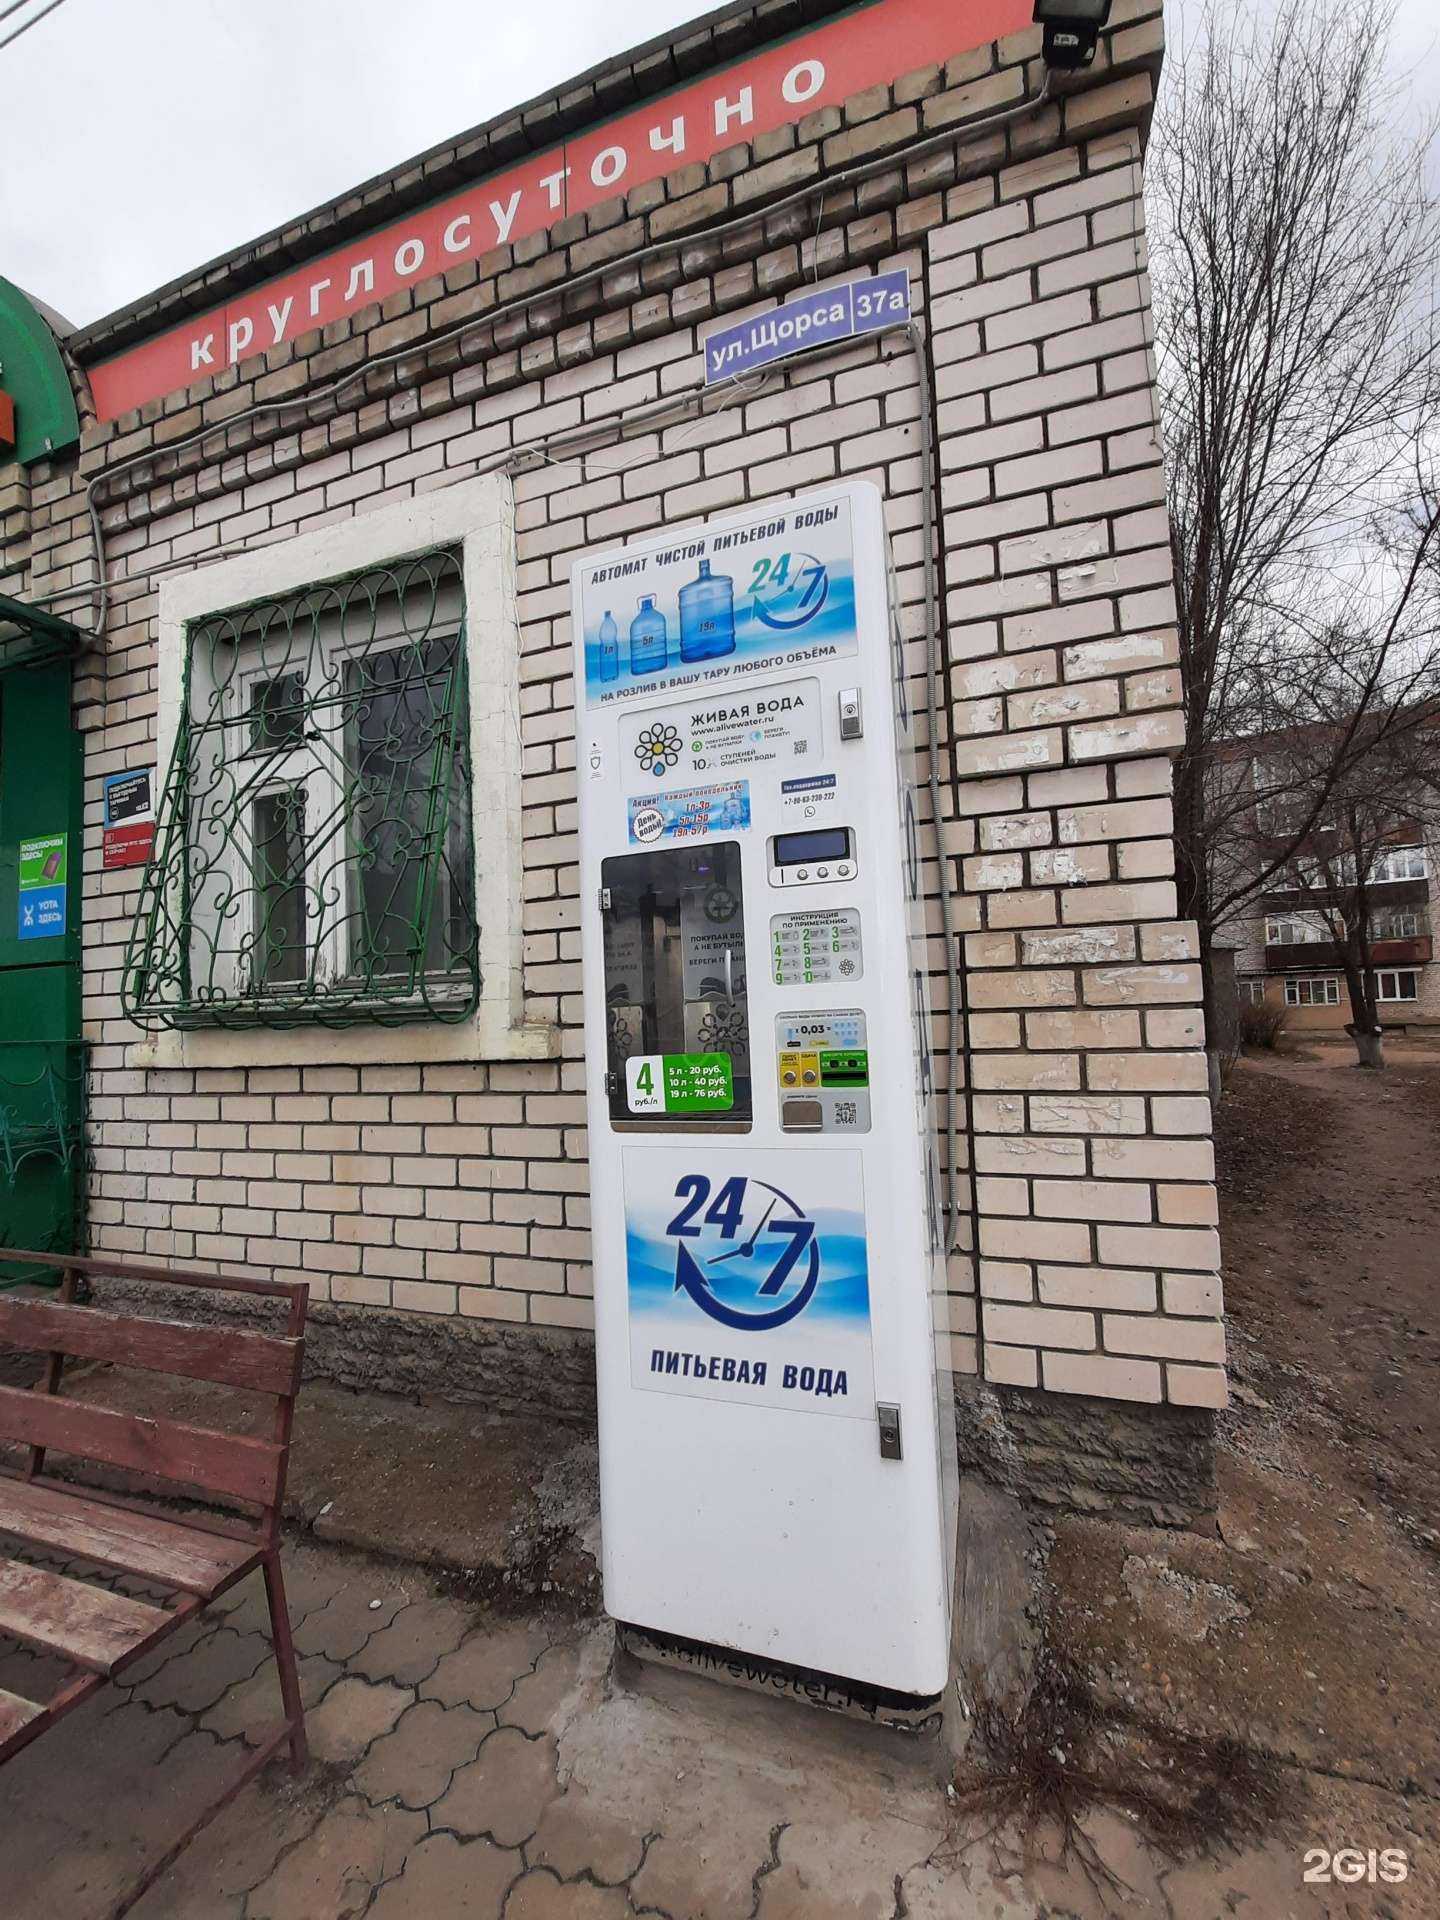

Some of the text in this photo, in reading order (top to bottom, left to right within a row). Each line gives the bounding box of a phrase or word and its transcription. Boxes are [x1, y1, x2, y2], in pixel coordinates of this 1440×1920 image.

[712, 289, 905, 371] ул.Щорса 37а
[591, 505, 840, 585] АВТОМАТ ЧИСТОЙ ПИТЬЕВОЙ ВОДЫ
[747, 552, 792, 594] 24
[600, 644, 838, 703] НА РОЗЛИВ В ВАШУ ТАРУ ЛЮБОГО ОБЪЁМА
[690, 695, 805, 727] ЖИВАЯ ВОДА
[690, 716, 775, 737] www.alivewater.ru
[691, 752, 777, 771] 10 ОЧИСТКИ ВОДЫ
[720, 748, 756, 761] СТУПЕНЕЙ
[790, 911, 839, 921] ИНСТРУКЦИЯ
[794, 918, 848, 927] ПРИМЕНЕНИЮ
[800, 1025, 825, 1036] 0,03
[636, 1062, 655, 1096] 4
[689, 1066, 701, 1074] 20
[702, 1065, 722, 1076] руб.
[669, 1078, 679, 1087] 10
[694, 1077, 706, 1086] 40
[708, 1076, 728, 1087] руб.
[634, 1097, 658, 1107] руб./л
[670, 1089, 680, 1098] 19
[694, 1089, 706, 1097] 76
[707, 1088, 727, 1098] руб.
[665, 1174, 816, 1296] 24 7
[650, 1348, 848, 1398] ПИТЬЕВАЯ ВОДА
